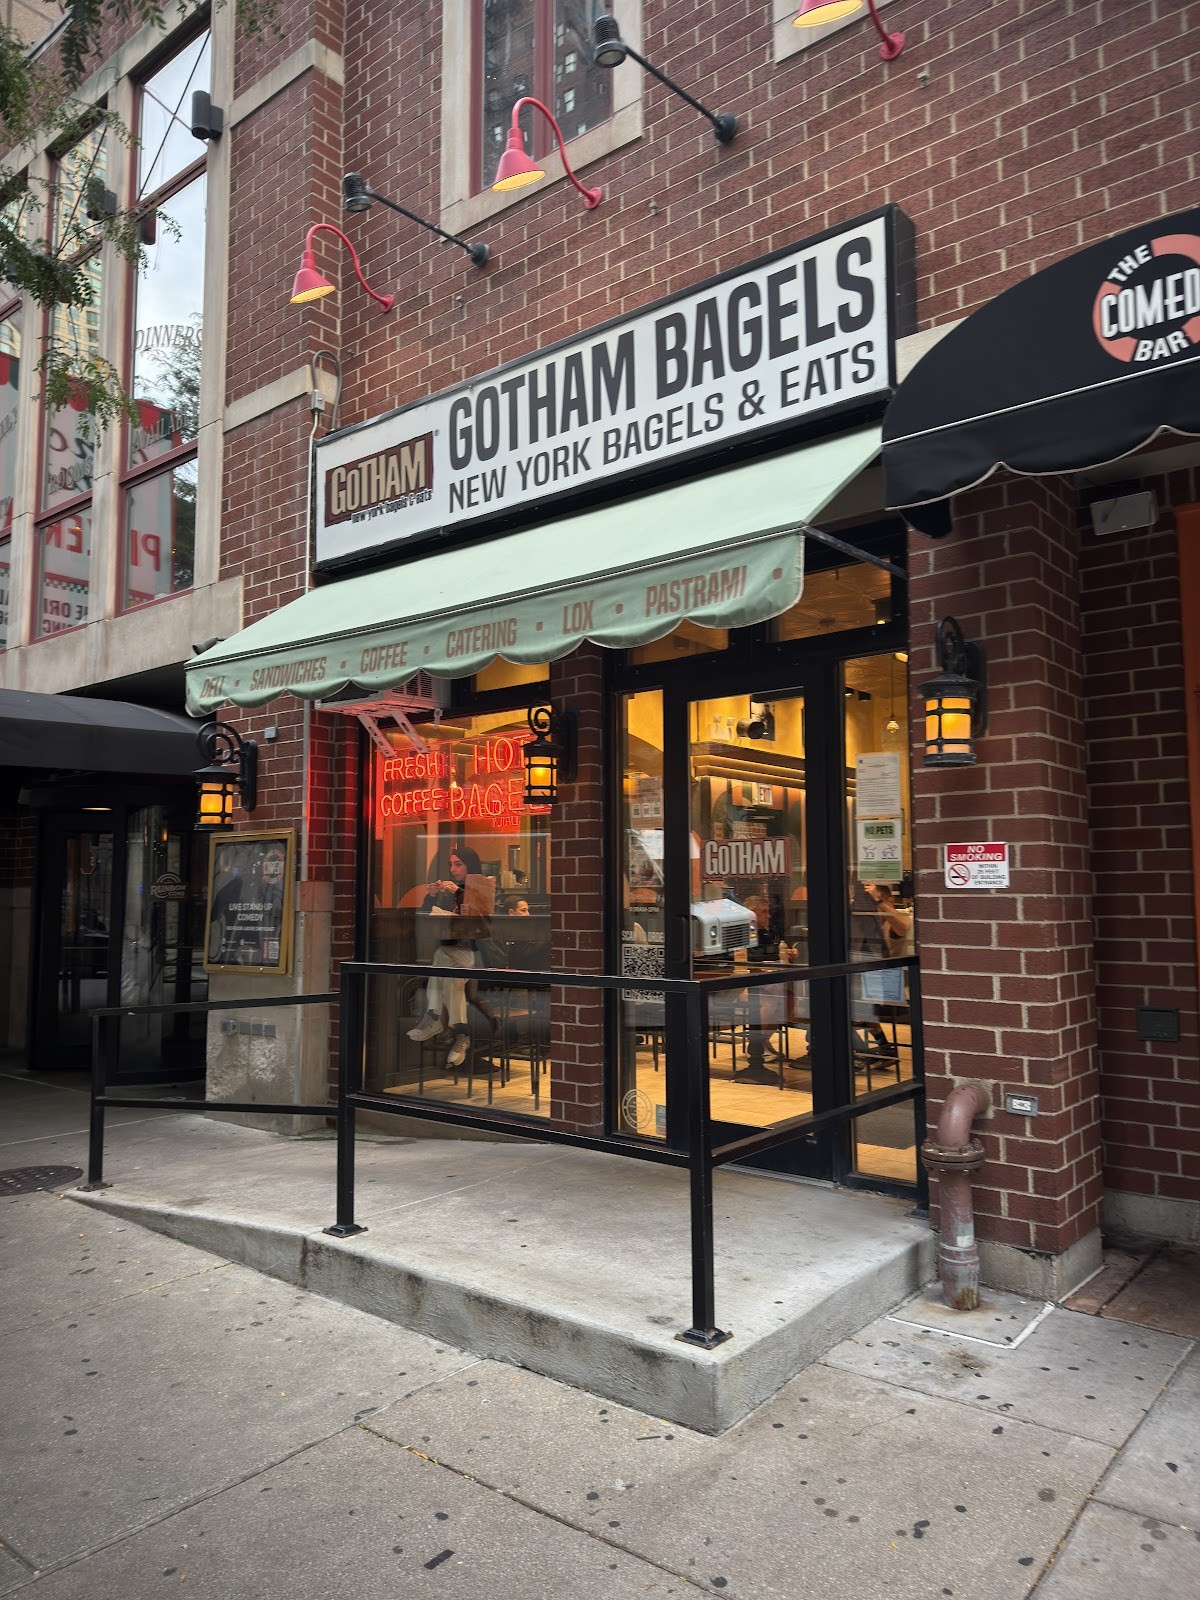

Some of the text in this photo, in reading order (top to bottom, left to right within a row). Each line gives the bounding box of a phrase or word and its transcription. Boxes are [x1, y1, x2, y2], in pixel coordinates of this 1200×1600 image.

[1107, 244, 1152, 283] THE
[1101, 268, 1200, 338] COMED
[448, 236, 875, 471] GOTHAM BAGELS
[1134, 331, 1190, 362] BAR
[449, 340, 876, 514] NEW YORK BAGELS & EATS
[200, 565, 748, 698] DELI SANDWICHES COFFEE CATERING LOX PASTRAMI
[383, 751, 441, 782] FRESH
[381, 788, 444, 817] COFFEE
[450, 778, 551, 820] BAGE
[876, 825, 894, 835] PETS
[704, 840, 786, 876] GOTHAM
[950, 853, 1003, 861] SMOKING
[967, 845, 985, 853] NO
[229, 903, 242, 911] LIVE
[237, 913, 264, 921] COMEDY
[648, 931, 665, 942] ORDE
